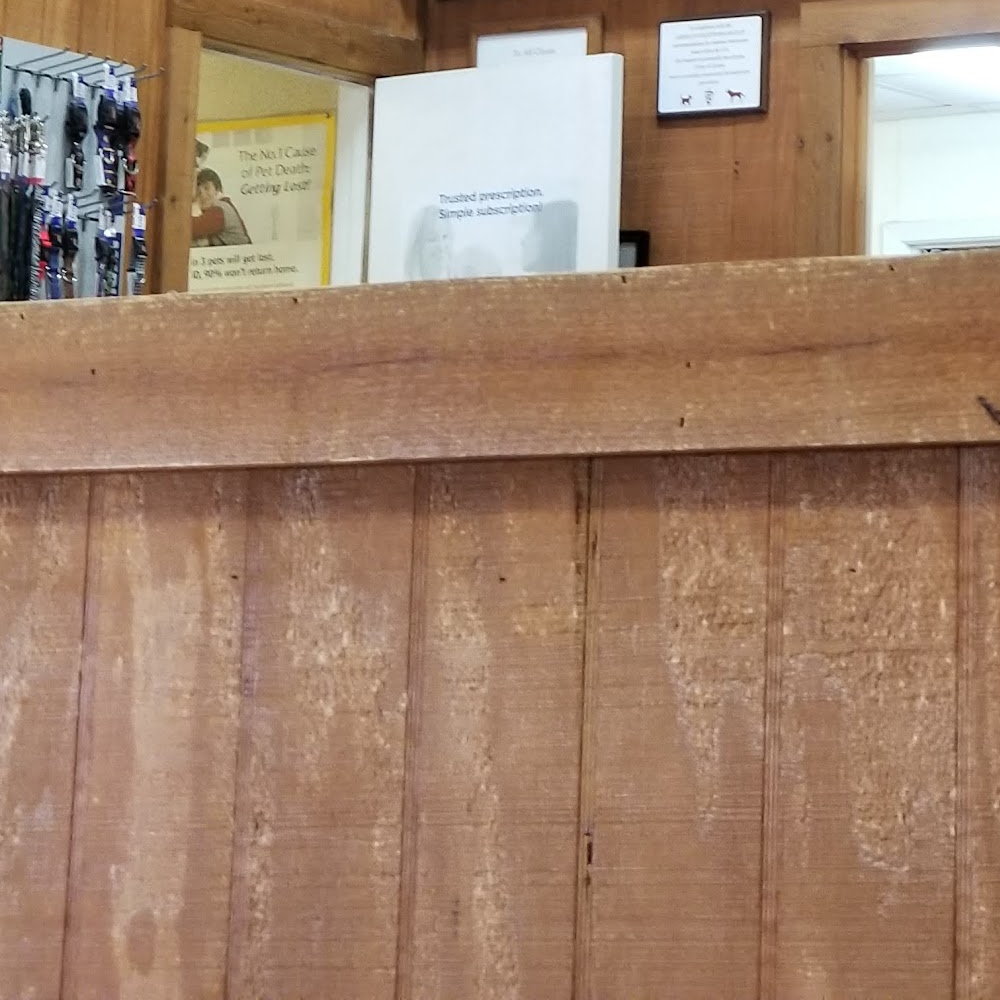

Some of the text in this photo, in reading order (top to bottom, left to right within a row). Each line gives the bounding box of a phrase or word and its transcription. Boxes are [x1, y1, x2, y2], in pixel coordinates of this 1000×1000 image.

[239, 150, 257, 162] The
[284, 146, 318, 158] Cause
[240, 165, 253, 178] of
[255, 165, 273, 177] Pet
[240, 182, 281, 195] Getting
[439, 188, 543, 204] Trusted prescription.
[439, 207, 474, 220] Simple
[227, 254, 240, 264] will
[242, 254, 256, 265] get
